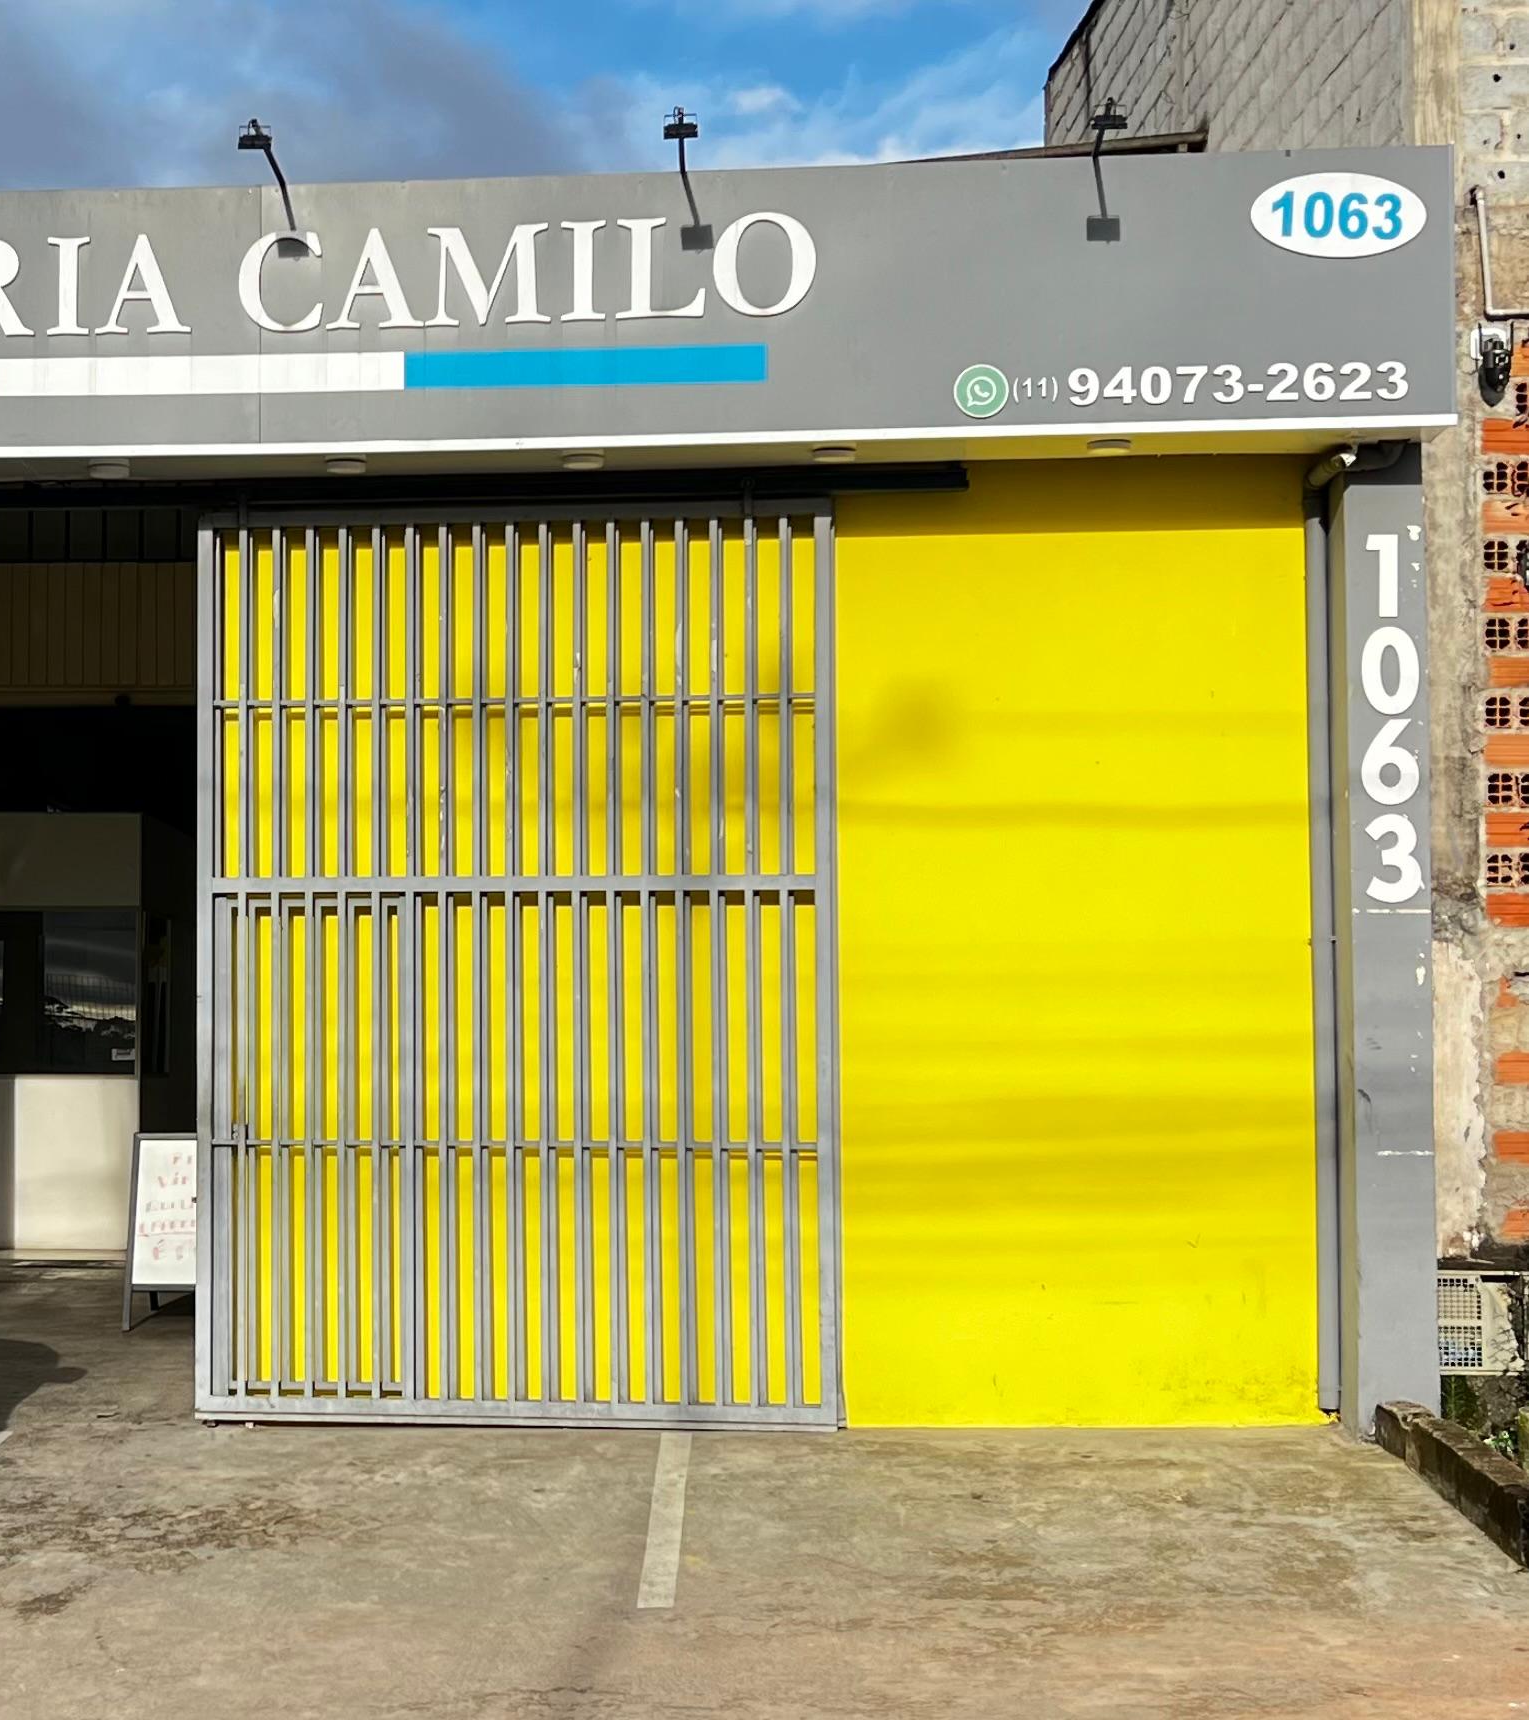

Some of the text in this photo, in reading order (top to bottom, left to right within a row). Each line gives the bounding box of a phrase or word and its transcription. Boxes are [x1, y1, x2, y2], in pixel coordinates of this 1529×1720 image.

[1270, 190, 1404, 240] 1063
[237, 211, 818, 335] CAMILO
[1012, 360, 1410, 407] (11) 94073-2623
[1360, 533, 1423, 904] 1063
